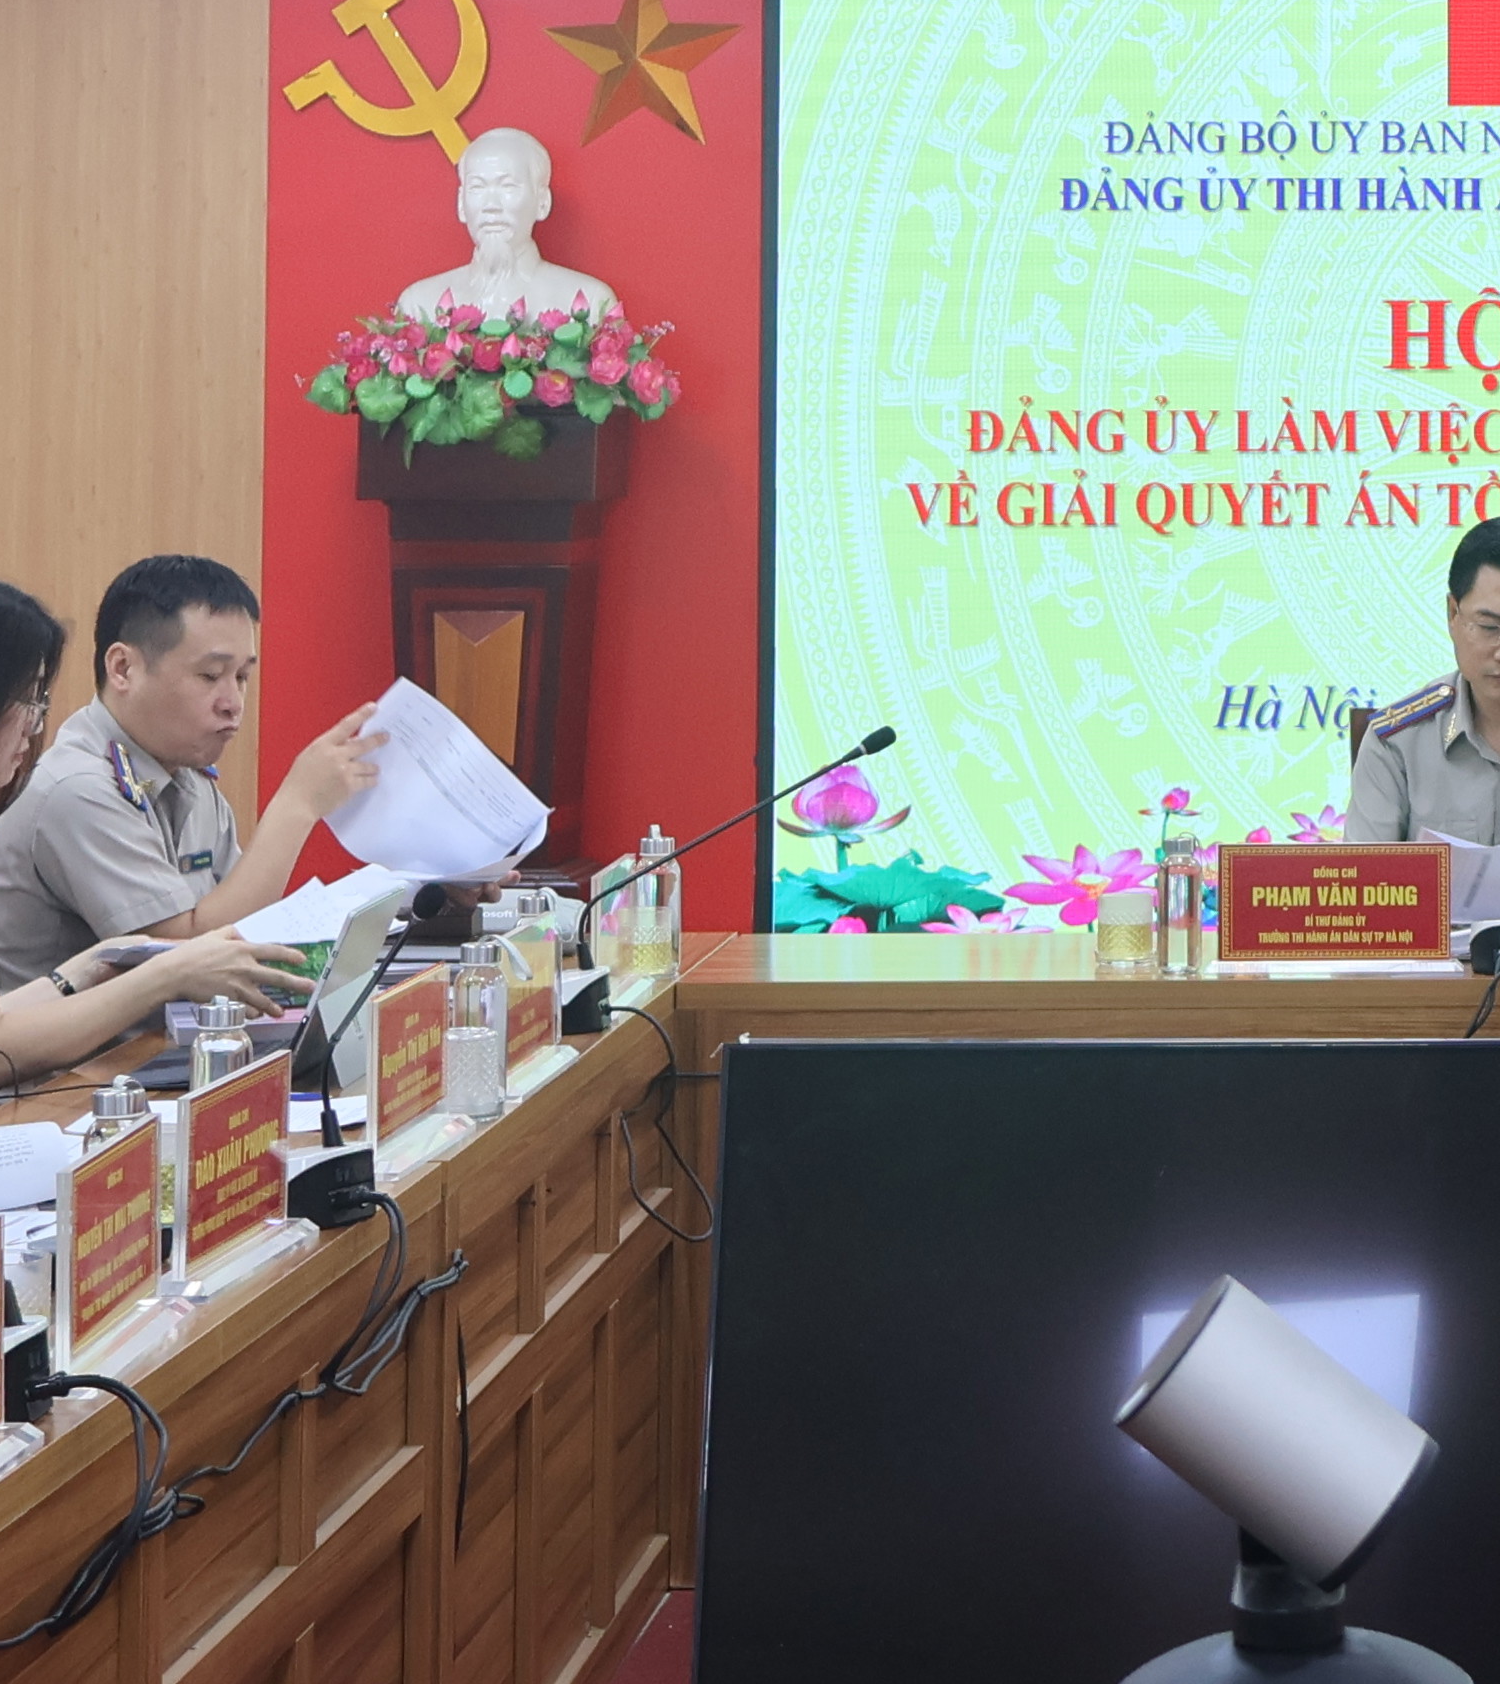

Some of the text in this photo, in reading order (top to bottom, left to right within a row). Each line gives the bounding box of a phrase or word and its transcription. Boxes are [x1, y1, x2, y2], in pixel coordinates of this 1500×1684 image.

[1104, 111, 1226, 155] ĐẢNG
[1240, 109, 1297, 161] BỘ
[1310, 111, 1369, 154] ỦY
[1381, 120, 1467, 154] BAN
[1061, 167, 1183, 212] ĐẢNG
[1198, 167, 1257, 212] ỦY
[1267, 178, 1343, 211] THI
[1358, 166, 1482, 211] HÀNH
[967, 396, 1125, 453] ĐẢNG
[1145, 396, 1218, 454] ỦY
[1236, 397, 1358, 453] LÀM
[907, 470, 979, 527] VỀ
[997, 470, 1117, 527] GIẢI
[1136, 470, 1330, 535] QUYẾT
[1345, 470, 1419, 527] ÁN
[1214, 684, 1284, 730] Hà
[1252, 882, 1418, 911] PHẠM VĂN DŨNG
